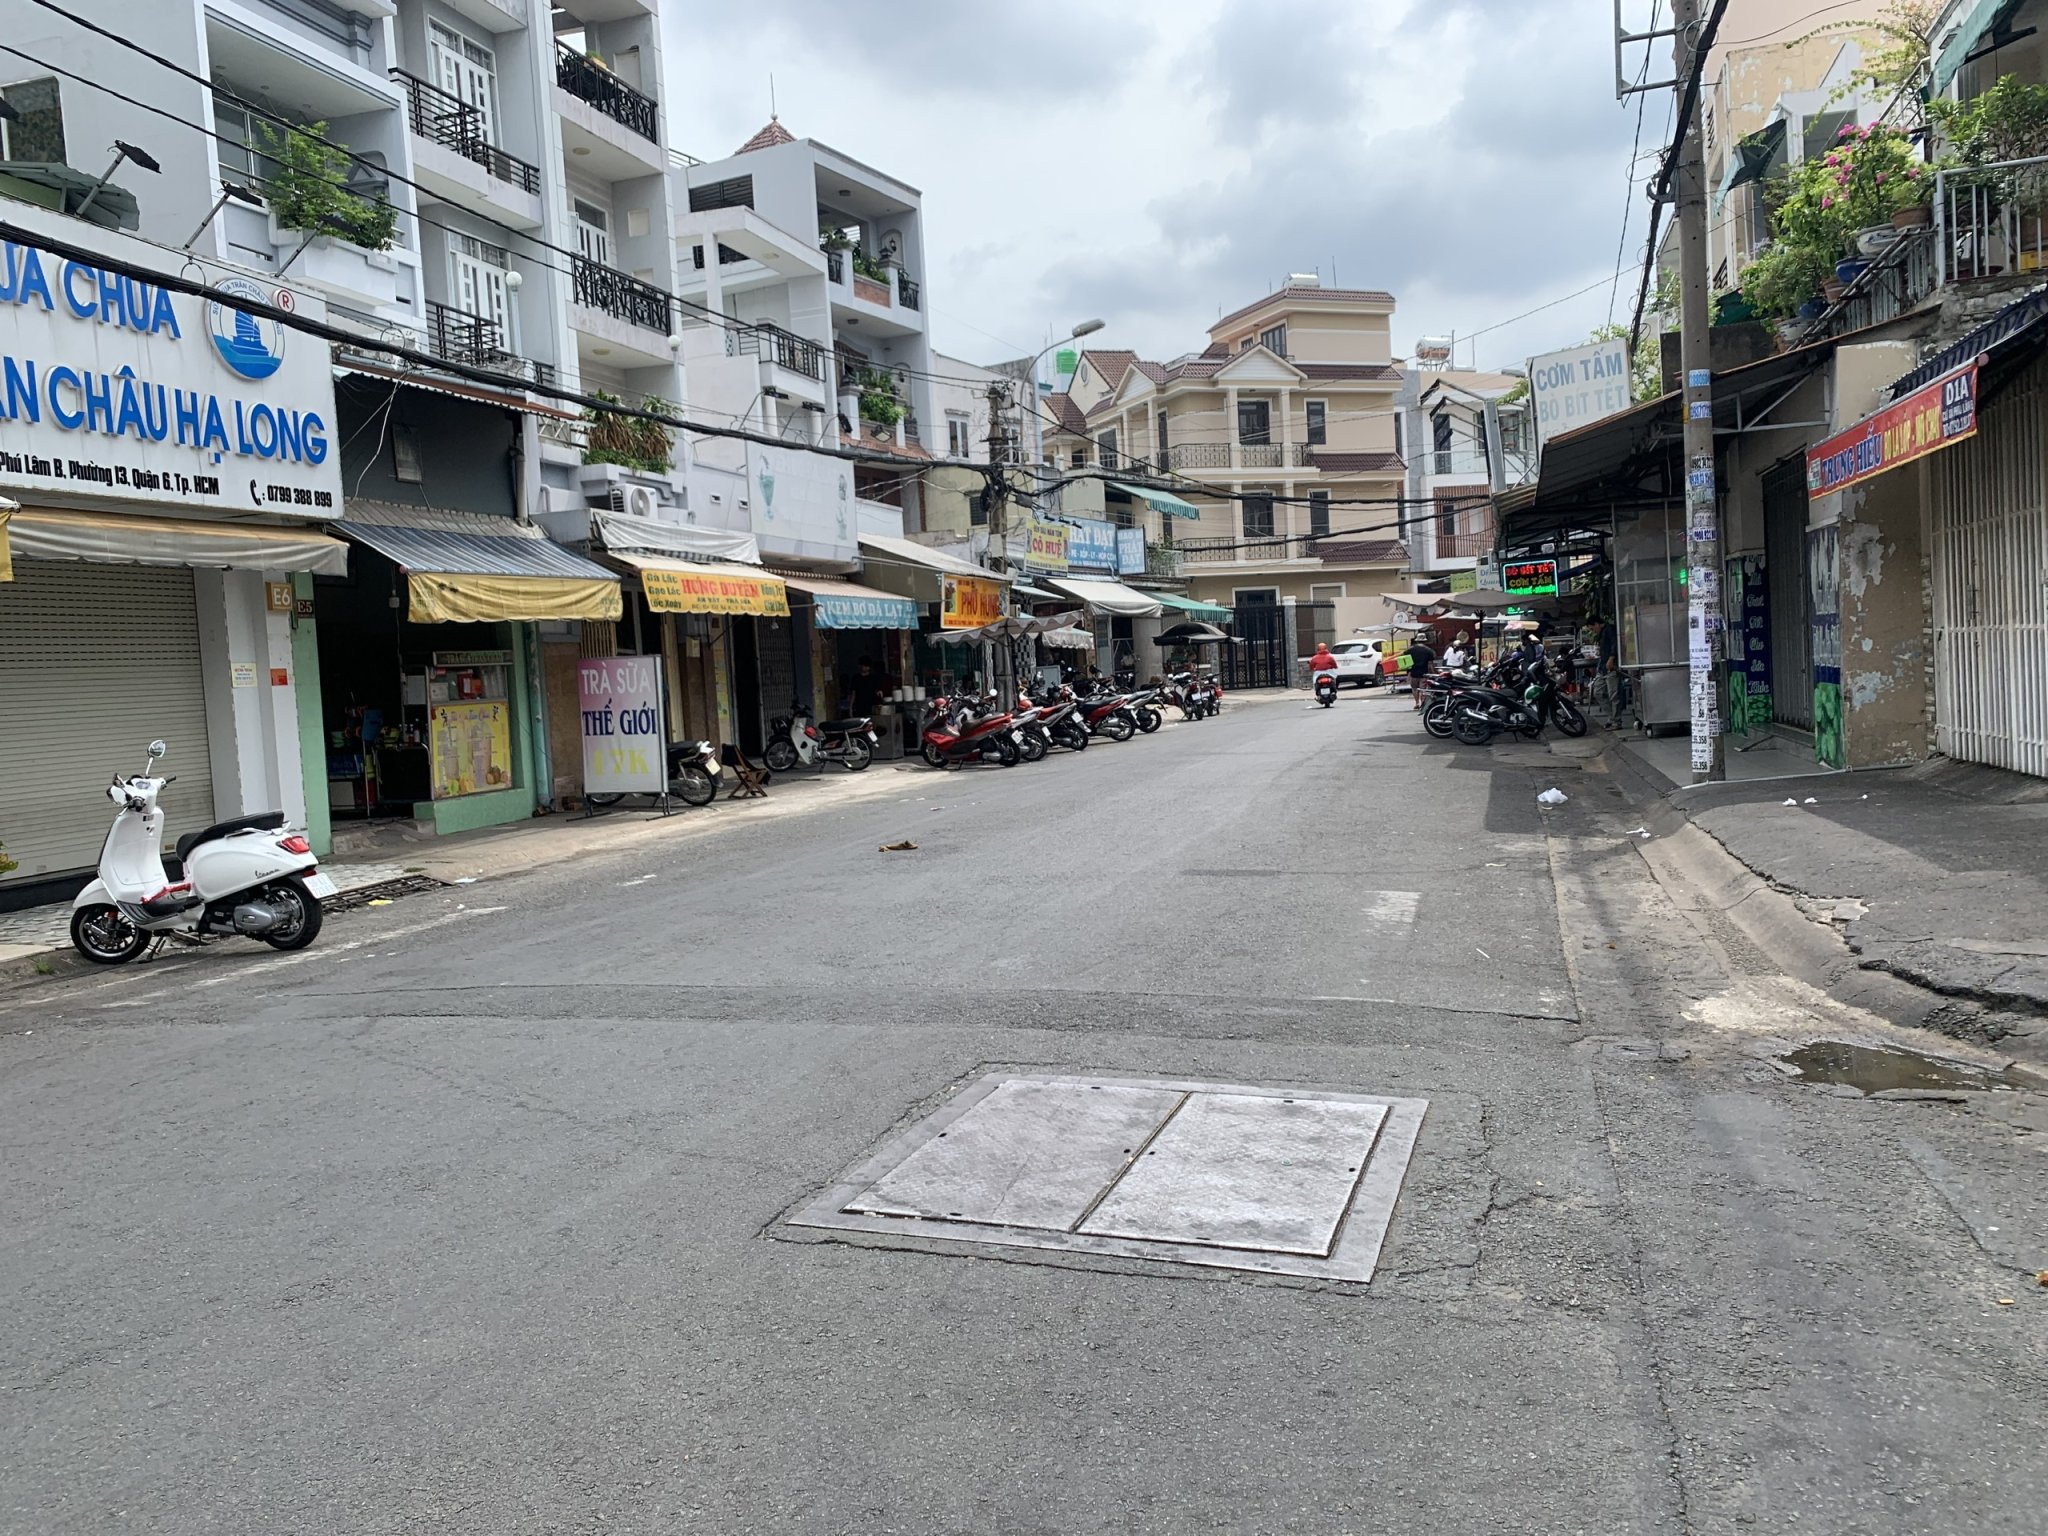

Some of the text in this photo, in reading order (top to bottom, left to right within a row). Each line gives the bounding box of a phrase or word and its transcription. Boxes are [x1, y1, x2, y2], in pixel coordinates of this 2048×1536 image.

[1536, 346, 1623, 392] CƠM TẤM
[48, 364, 167, 442] CHÂU
[174, 387, 231, 464] HẠ
[234, 400, 328, 466] LONG
[1822, 446, 1855, 489] TRUNG
[1856, 421, 1883, 473] HIẾU
[25, 454, 51, 477] Lâm
[69, 460, 113, 487] Phường
[132, 469, 160, 492] Quận
[194, 477, 220, 496] HCM
[266, 484, 333, 508] 0799 388 899
[1093, 526, 1115, 549] ĐẠT
[273, 589, 291, 607] E6
[1509, 573, 1552, 588] CƠM TẤM
[297, 601, 313, 613] E5
[581, 661, 652, 696] TRÀ SỮA
[582, 697, 658, 737] THẾ GIỚI
